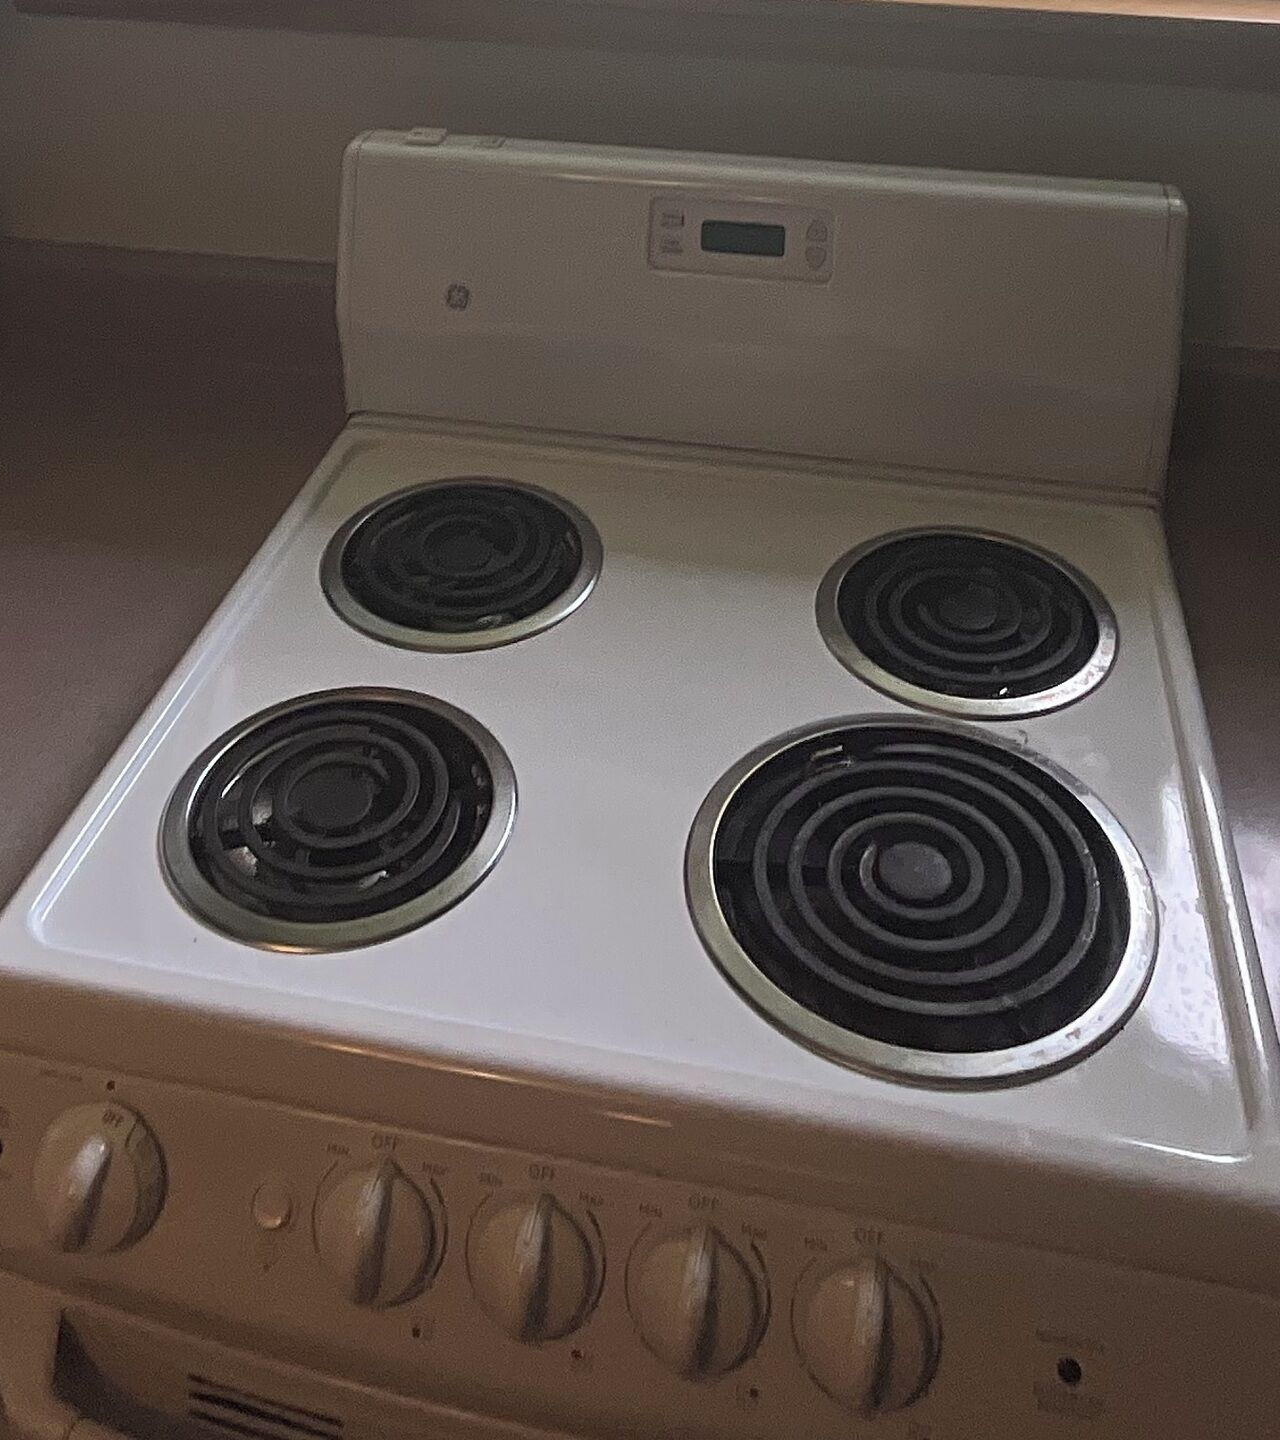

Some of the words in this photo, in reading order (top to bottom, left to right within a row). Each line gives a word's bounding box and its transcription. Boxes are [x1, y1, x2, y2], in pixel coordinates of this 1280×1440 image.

[371, 1133, 400, 1150] OFF
[529, 1163, 556, 1181] OFF
[688, 1193, 721, 1211] OFF
[854, 1227, 884, 1245] OFF
